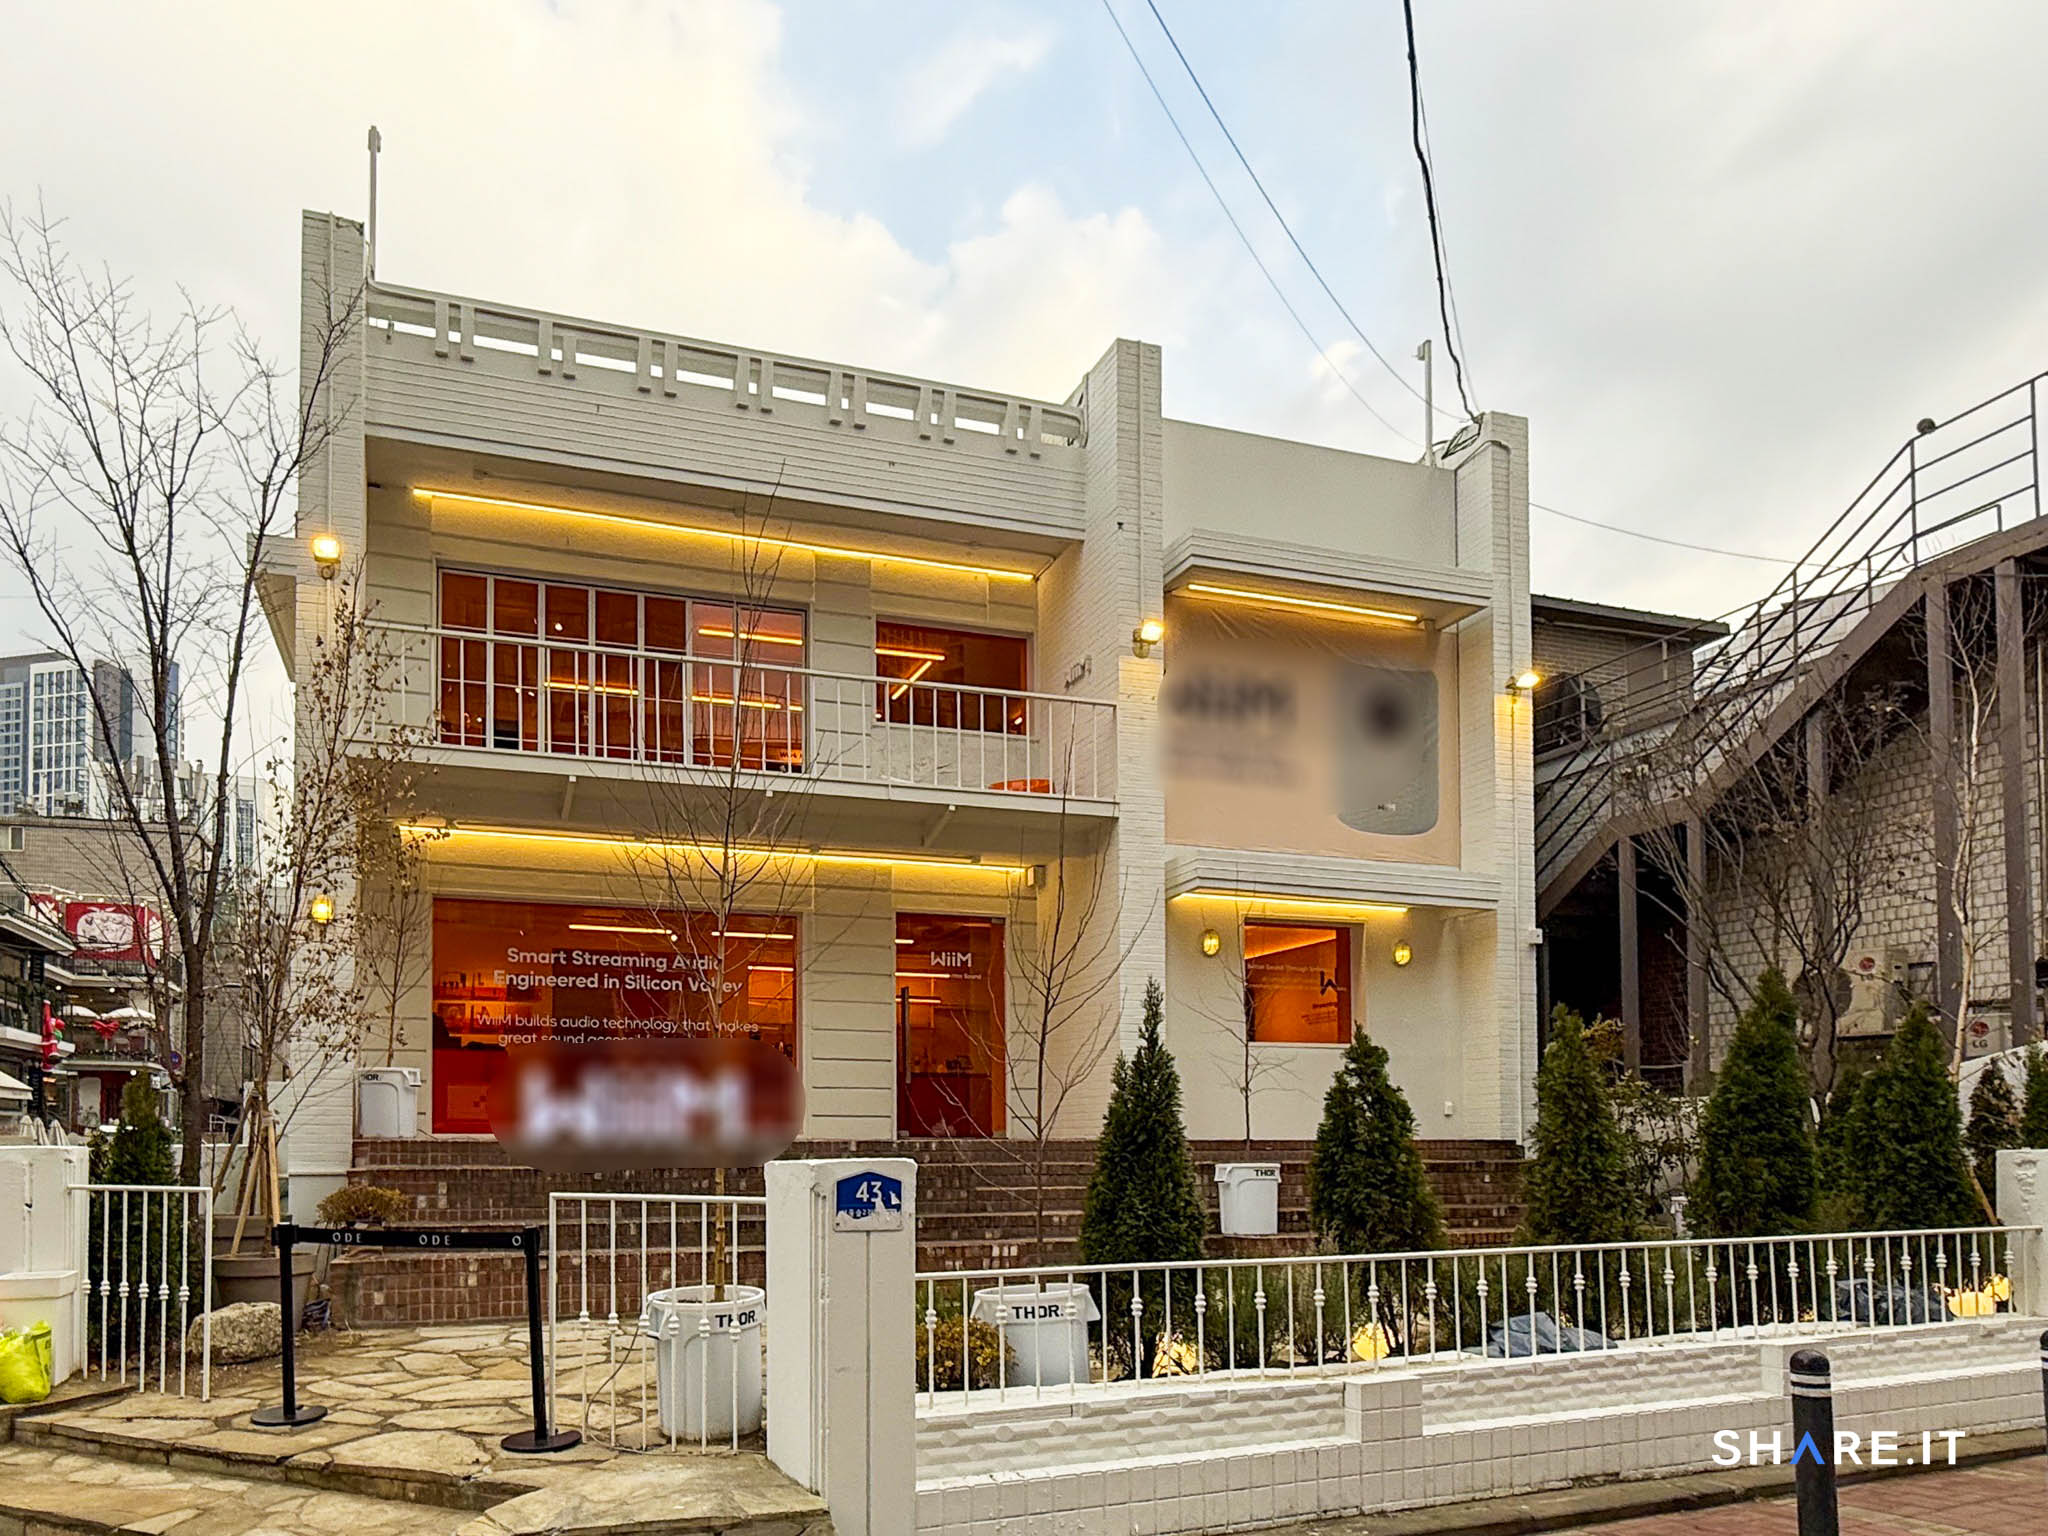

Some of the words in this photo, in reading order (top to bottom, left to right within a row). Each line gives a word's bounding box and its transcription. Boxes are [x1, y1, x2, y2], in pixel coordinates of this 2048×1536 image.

[507, 948, 567, 965] Smart
[572, 950, 667, 973] Streaming
[930, 951, 972, 968] WiiM
[493, 970, 599, 989] Engineered
[603, 971, 620, 989] in
[625, 973, 683, 992] Silicon
[515, 1013, 558, 1027] builds
[560, 1015, 600, 1029] audio
[602, 1016, 678, 1034] technology
[682, 1018, 711, 1032] that
[498, 1032, 537, 1047] great
[855, 1181, 883, 1203] 43
[332, 1232, 362, 1244] ODE
[419, 1234, 451, 1246] ODE
